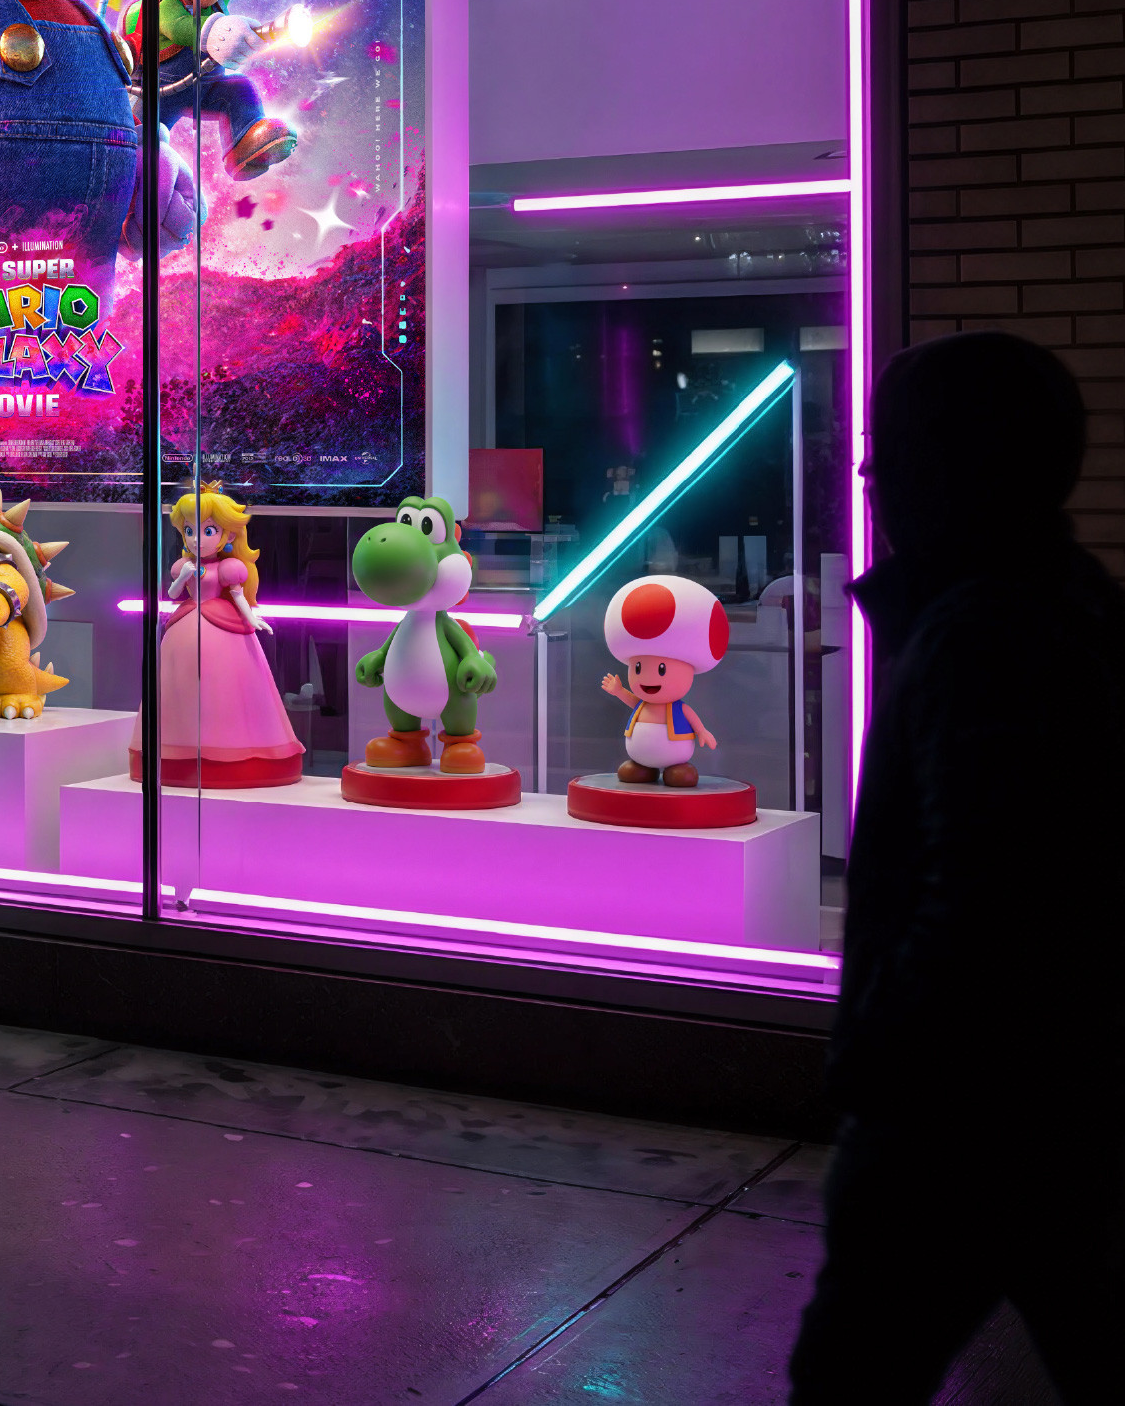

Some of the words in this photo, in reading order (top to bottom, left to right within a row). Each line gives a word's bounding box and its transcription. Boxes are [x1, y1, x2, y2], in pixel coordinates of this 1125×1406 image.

[375, 69, 381, 88] WE
[22, 240, 63, 252] ILLUMINATION
[2, 257, 75, 281] SUPER
